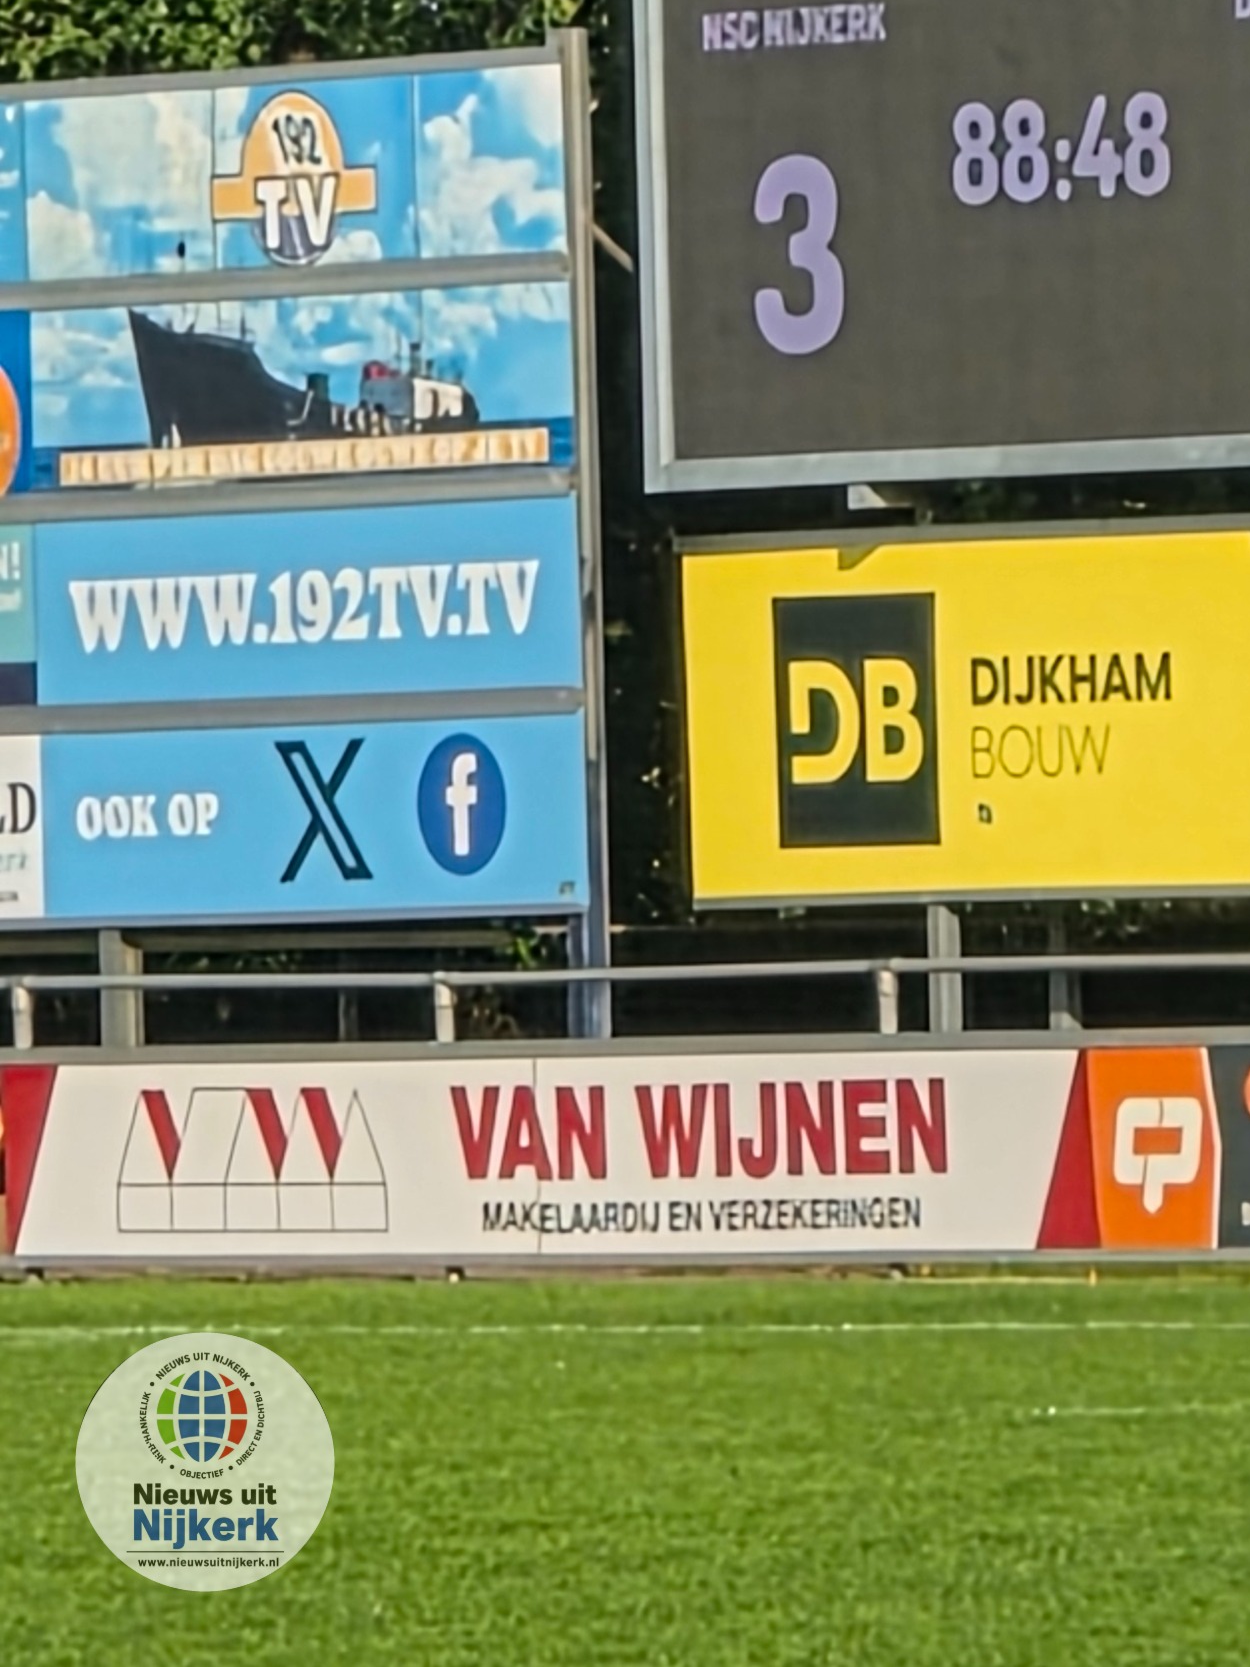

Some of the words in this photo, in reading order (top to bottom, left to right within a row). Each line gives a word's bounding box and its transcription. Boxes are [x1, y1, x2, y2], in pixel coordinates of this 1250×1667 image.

[763, 1, 887, 47] NIJKERK
[271, 113, 322, 167] 192
[950, 91, 1172, 206] 88:48
[254, 173, 338, 251] TV
[753, 153, 845, 355] 3
[68, 558, 540, 655] WWW.192TV.TV
[970, 651, 1173, 707] DIJKHAM
[788, 656, 925, 786] DB
[971, 723, 1111, 780] BOUW
[76, 794, 158, 840] OOK
[168, 792, 219, 837] OP
[450, 1084, 607, 1181] VAN
[634, 1078, 949, 1180] WIJNEN
[481, 1200, 661, 1234] MAKELAARDIJ
[668, 1201, 702, 1233] EN
[707, 1196, 922, 1233] VERZEKERINGEN
